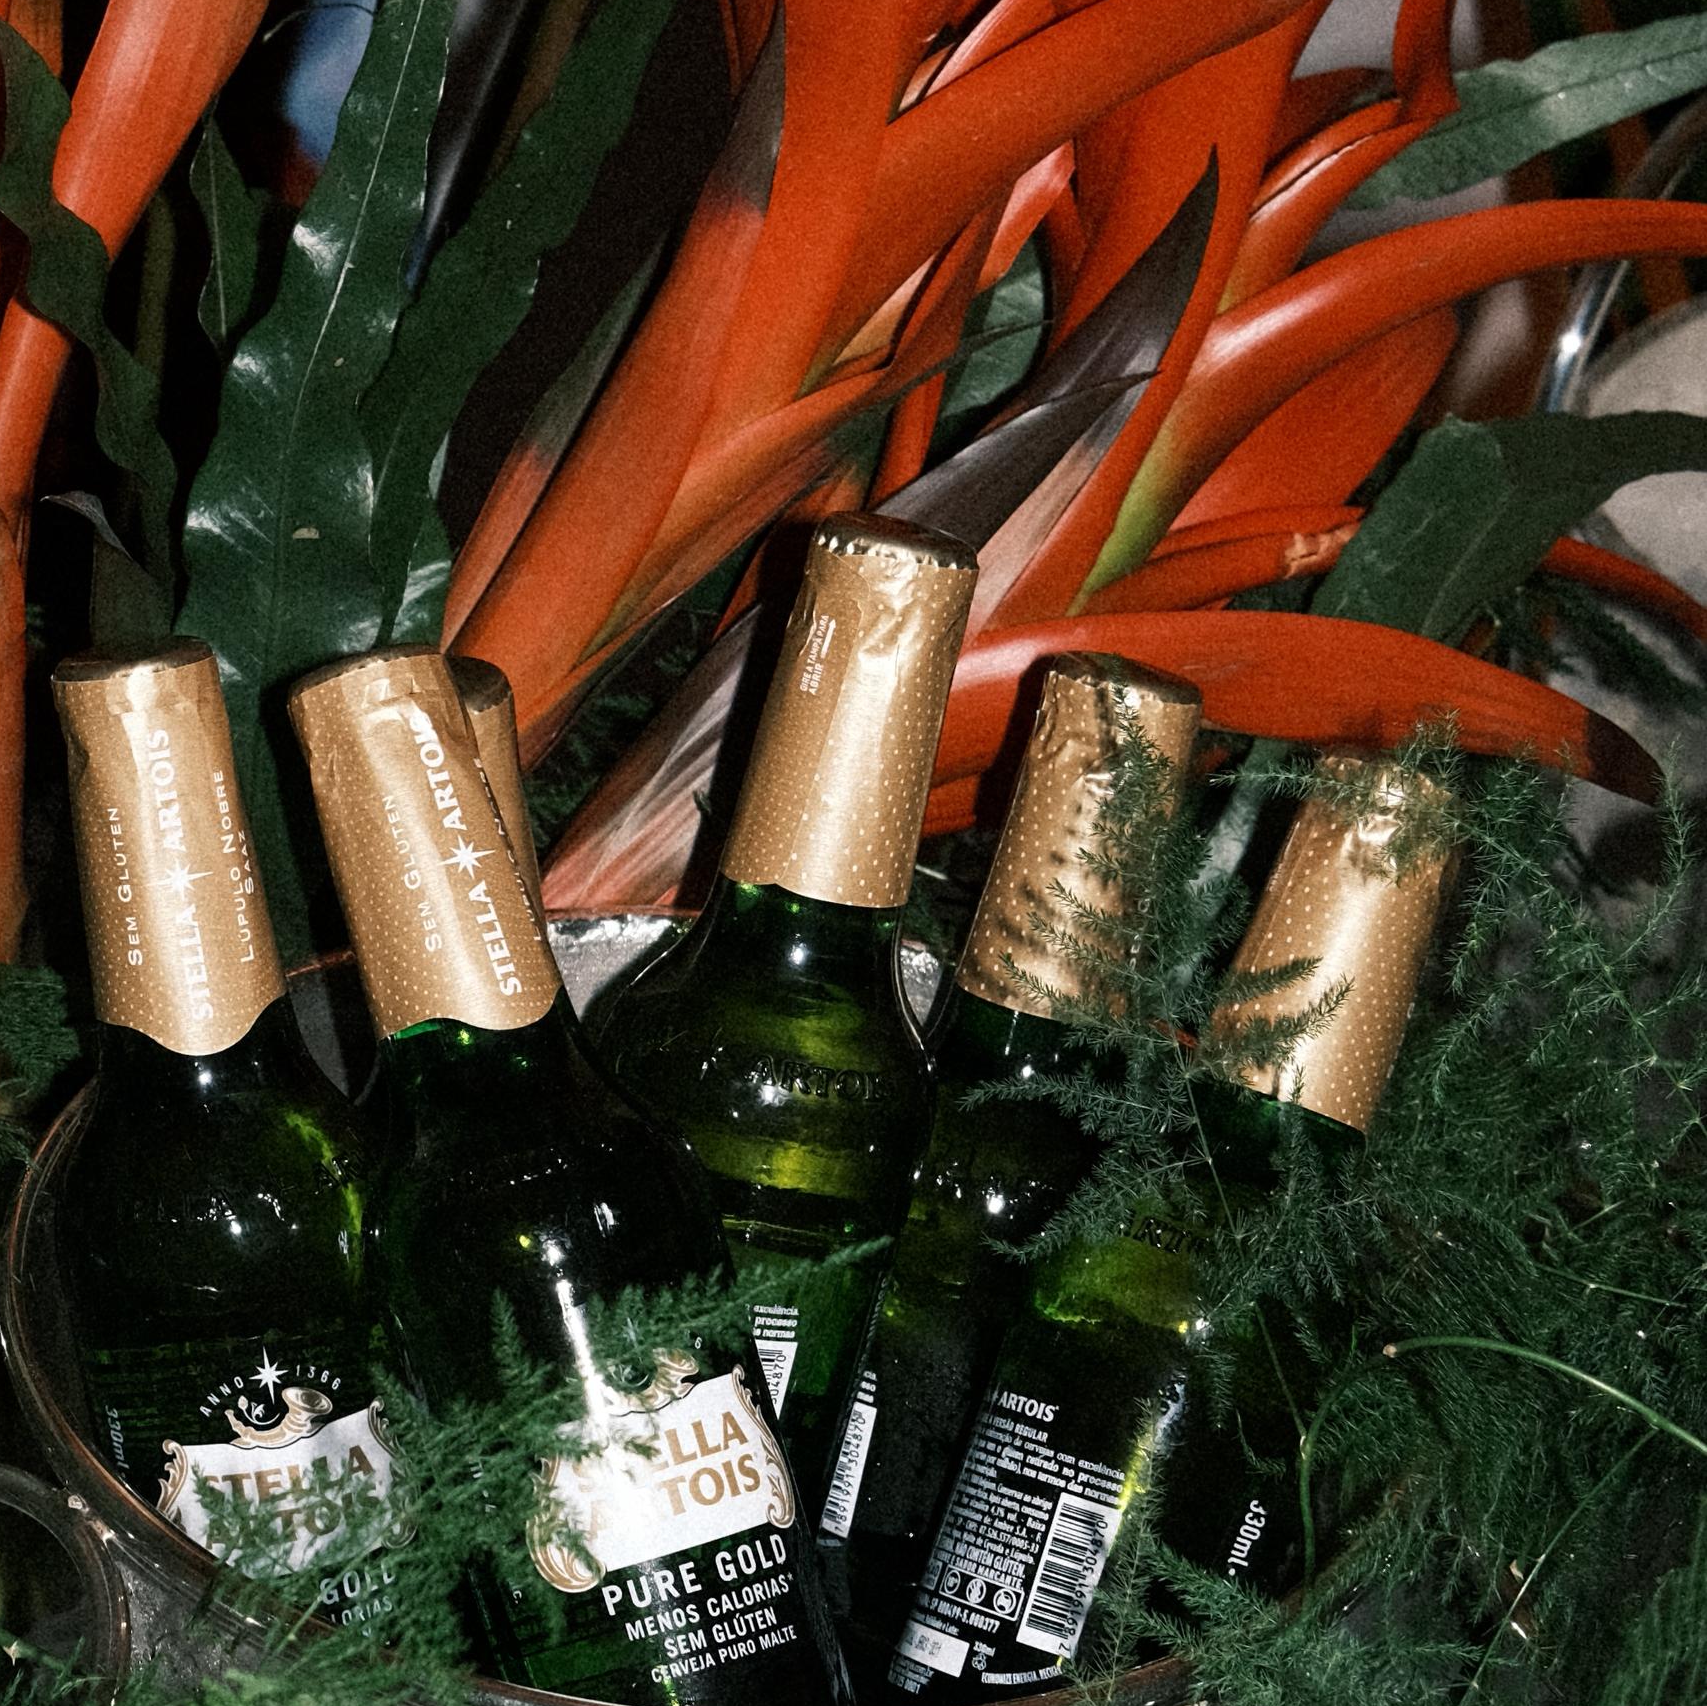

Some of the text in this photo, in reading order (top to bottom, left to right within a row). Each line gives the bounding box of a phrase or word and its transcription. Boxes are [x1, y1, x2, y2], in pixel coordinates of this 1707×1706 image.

[212, 769, 236, 854] NOBRE
[148, 729, 214, 1021] STELLA ARTOIS
[237, 830, 255, 895] SAAZ
[468, 880, 522, 996] STELLA
[199, 1364, 342, 1418] ANNO 1366
[997, 1391, 1054, 1423] ARTOIS
[601, 1533, 787, 1616] PURE GOLD
[1058, 1519, 1109, 1654] 7 891991 304870
[625, 1603, 701, 1641] MENOS
[650, 1624, 798, 1684] CERVEJA PURO MALTE
[664, 1605, 778, 1659] SEM GLÚTEN
